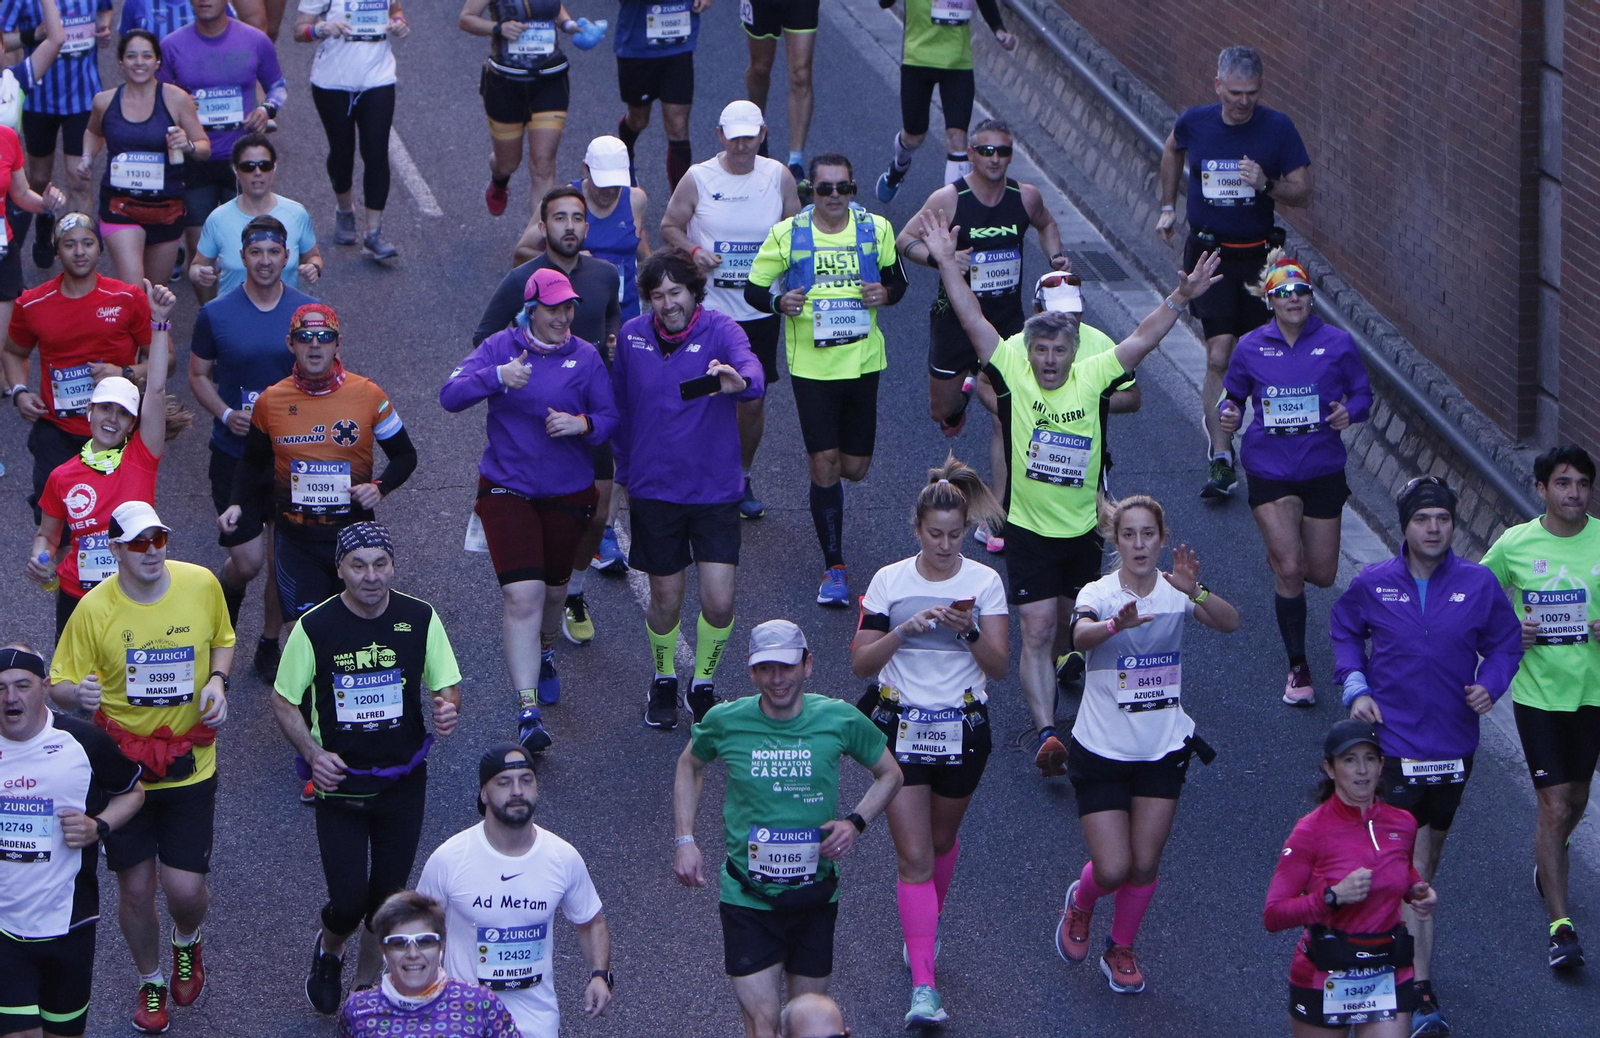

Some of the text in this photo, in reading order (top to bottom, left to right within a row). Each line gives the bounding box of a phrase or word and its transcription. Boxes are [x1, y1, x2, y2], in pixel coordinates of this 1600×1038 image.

[65, 16, 91, 24] ZURICH
[208, 89, 236, 97] ZURICH
[1219, 162, 1239, 170] ZURI
[126, 170, 151, 178] 11310
[816, 252, 857, 269] JUST
[987, 251, 1015, 261] ZURICH
[986, 269, 1010, 278] 10094
[980, 281, 994, 289] JOSÉ
[829, 316, 856, 325] 12008
[64, 368, 91, 379] ZURIC
[65, 384, 92, 395] 13972
[1279, 386, 1312, 395] ZURICH
[1277, 403, 1304, 412] 13241
[1274, 416, 1309, 425] LAGARTIJA
[283, 434, 325, 444] NARANJO
[1052, 435, 1086, 447] ZURICH
[1048, 453, 1071, 465] 9501
[1031, 462, 1082, 477] ANTONIO SERRA
[306, 483, 335, 492] 10391
[68, 517, 98, 531] MER
[95, 556, 118, 565] 1357
[1541, 593, 1578, 603] ZURICH
[1540, 613, 1571, 622] 10079
[174, 626, 190, 634] asics
[1540, 625, 1584, 635] SANDROSSI
[149, 651, 187, 661] ZURICH
[333, 652, 354, 661] MARA
[1139, 655, 1173, 666] ZURICH
[335, 658, 355, 667] TONA
[149, 672, 176, 683] 9399
[357, 673, 394, 686] ZURICH
[1138, 676, 1162, 687] 8419
[145, 686, 177, 695] MAKSIM
[1134, 690, 1165, 700] AZUCENA
[354, 693, 386, 706] 12001
[356, 710, 386, 720] ALFRED
[920, 711, 955, 721] ZURICH
[916, 731, 947, 741] 11205
[912, 744, 947, 753] MANUELA
[751, 750, 812, 760] MONTEPIO
[750, 767, 812, 777] CASCAIS
[1413, 763, 1455, 773] MIMITORPEZ
[3, 775, 37, 790] edp
[3, 802, 44, 813] ZURICH
[0, 822, 33, 833] 12749
[773, 831, 812, 841] ZURICH
[0, 839, 37, 850] ÁRDENAS
[768, 854, 802, 863] 10165
[759, 864, 807, 875] NUNO OTERO
[472, 894, 548, 911] Ad Metam
[502, 928, 540, 941] ZURICH
[497, 949, 531, 961] 12432
[492, 966, 533, 977] AD METAM
[1344, 984, 1376, 996] 13420
[1342, 1000, 1377, 1010] 1669534
